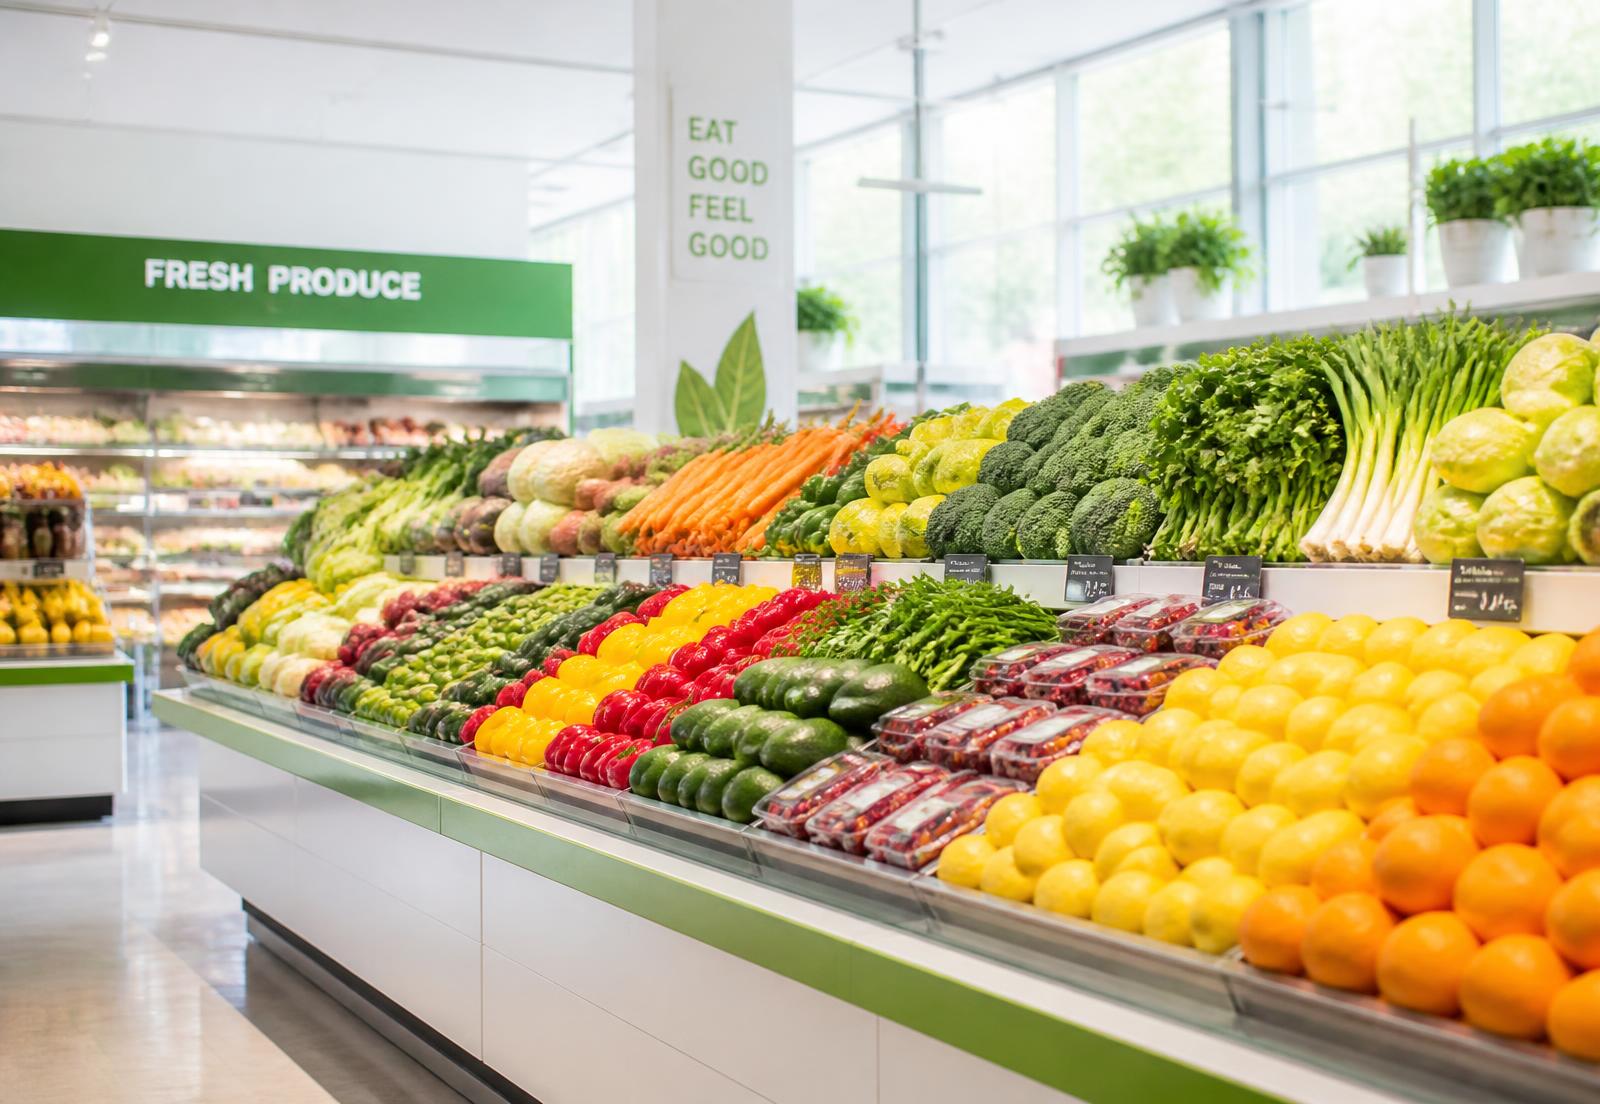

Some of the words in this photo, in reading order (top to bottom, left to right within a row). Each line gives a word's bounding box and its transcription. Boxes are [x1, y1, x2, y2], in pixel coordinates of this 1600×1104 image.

[689, 117, 738, 143] EAT
[688, 156, 769, 185] GOOD
[689, 194, 754, 223] FEEL
[688, 232, 769, 261] GOOD
[144, 258, 254, 293] FRESH
[268, 265, 422, 302] PRODUCE
